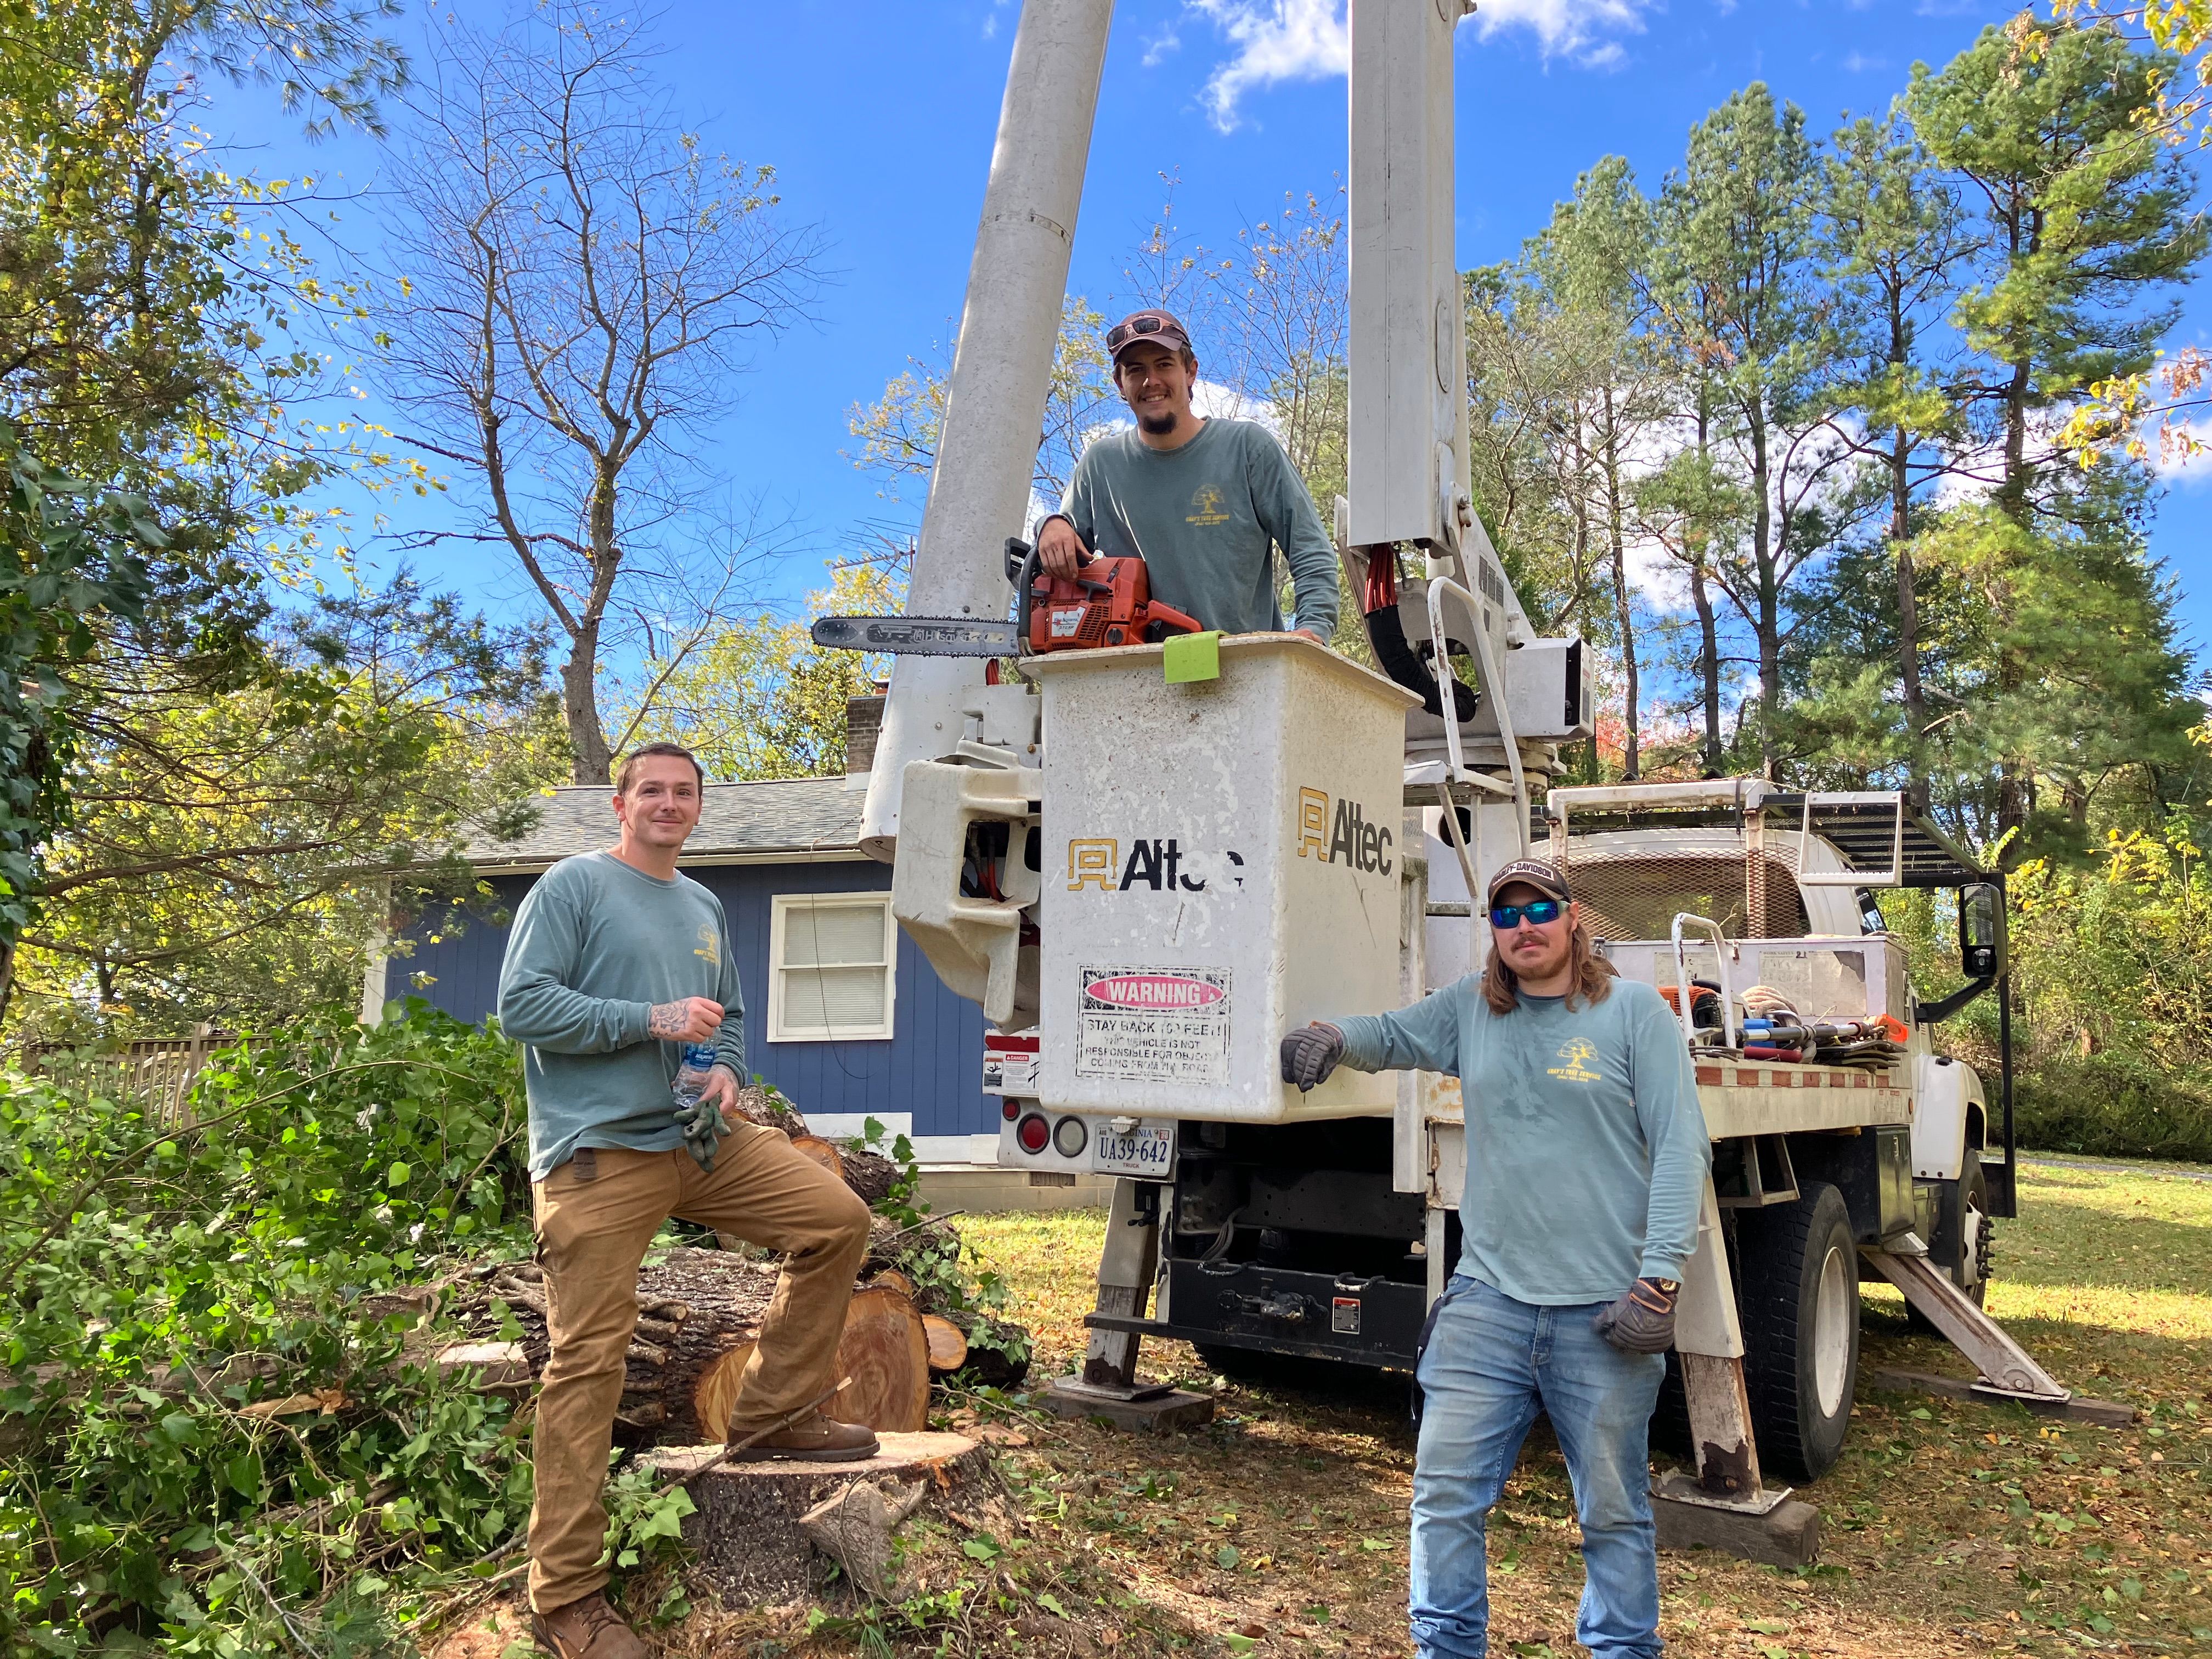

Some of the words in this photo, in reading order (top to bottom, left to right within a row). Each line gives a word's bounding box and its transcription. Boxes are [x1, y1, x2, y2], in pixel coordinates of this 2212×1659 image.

[1329, 798, 1392, 876] Altec
[1119, 839, 1244, 891] Alt
[1109, 981, 1201, 1004] WARNING
[1088, 1019, 1117, 1031] STAY
[1121, 1020, 1155, 1033] BACK
[1127, 1037, 1166, 1047] VEHICLE
[1170, 1040, 1178, 1048] IS
[1181, 1040, 1201, 1049] NOT
[1086, 1046, 1150, 1058] RESPONSIBLE
[1153, 1050, 1172, 1059] FOR
[1091, 1058, 1128, 1068] COING
[1100, 1137, 1167, 1163] UA39-642
